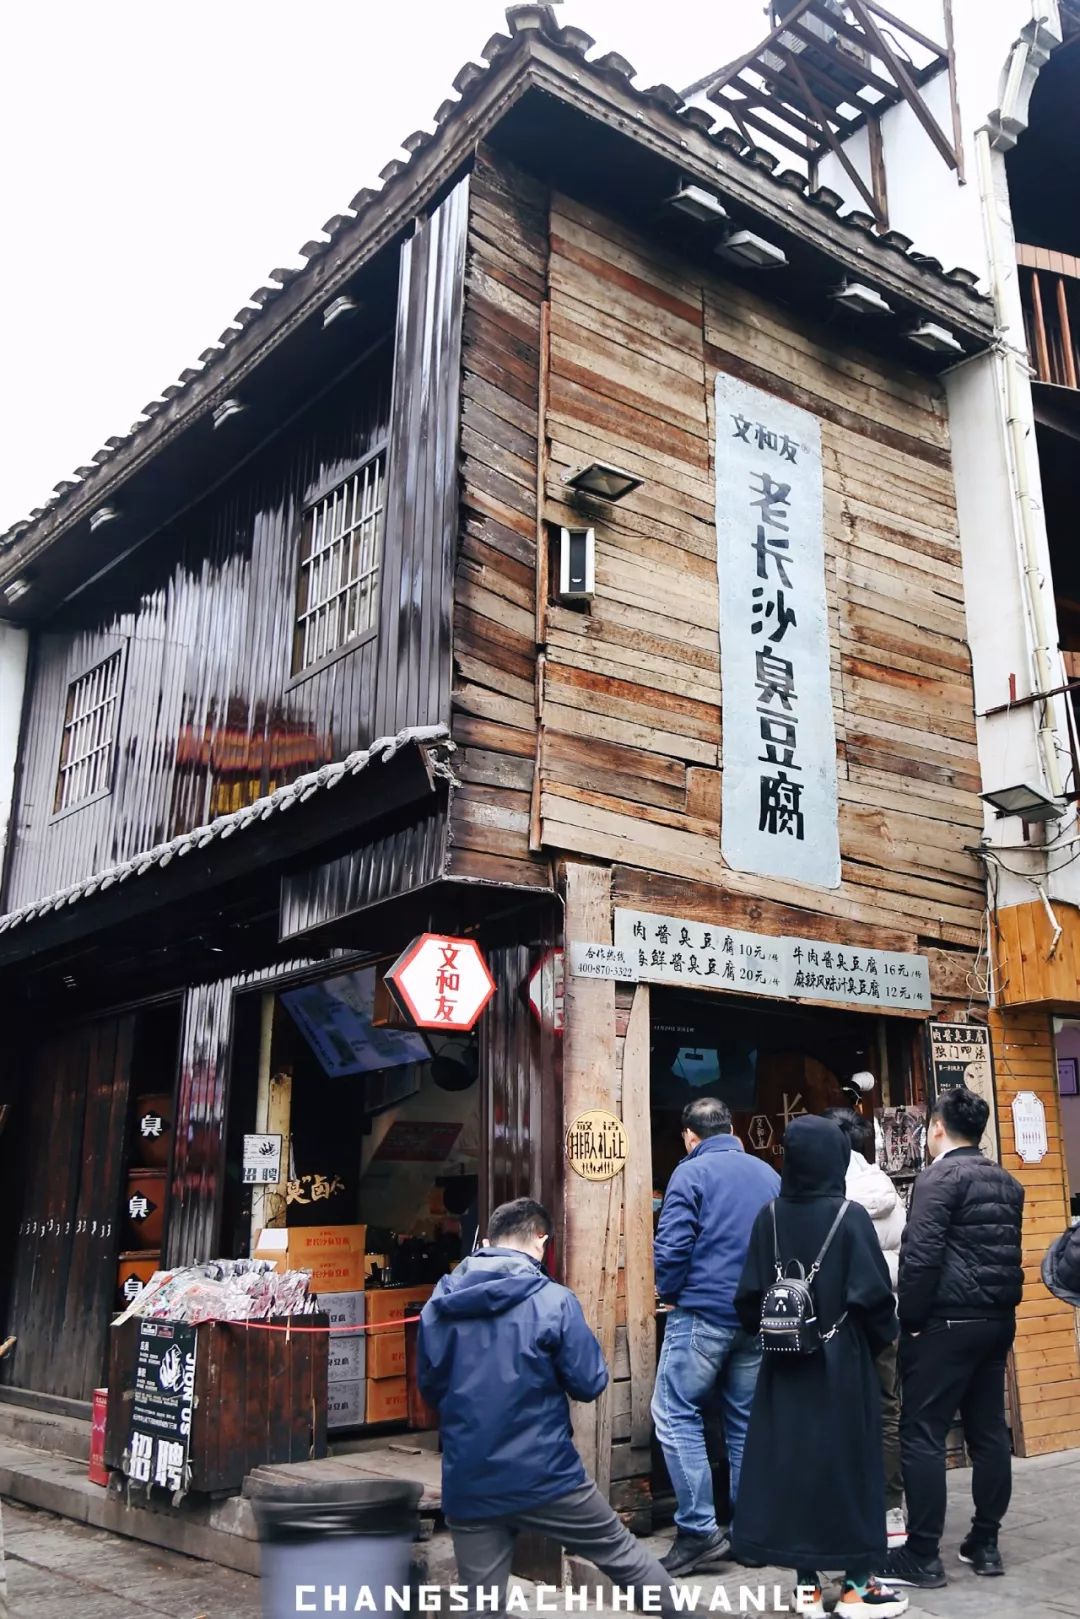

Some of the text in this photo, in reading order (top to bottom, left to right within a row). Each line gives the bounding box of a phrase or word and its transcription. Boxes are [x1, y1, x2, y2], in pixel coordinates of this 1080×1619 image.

[749, 471, 805, 840] 老长沙臭豆腐
[434, 944, 461, 1022] 文和友
[140, 1115, 162, 1136] 臭
[129, 1196, 149, 1218] 臭
[180, 1408, 192, 1435] US
[129, 1431, 184, 1491] 招聘
